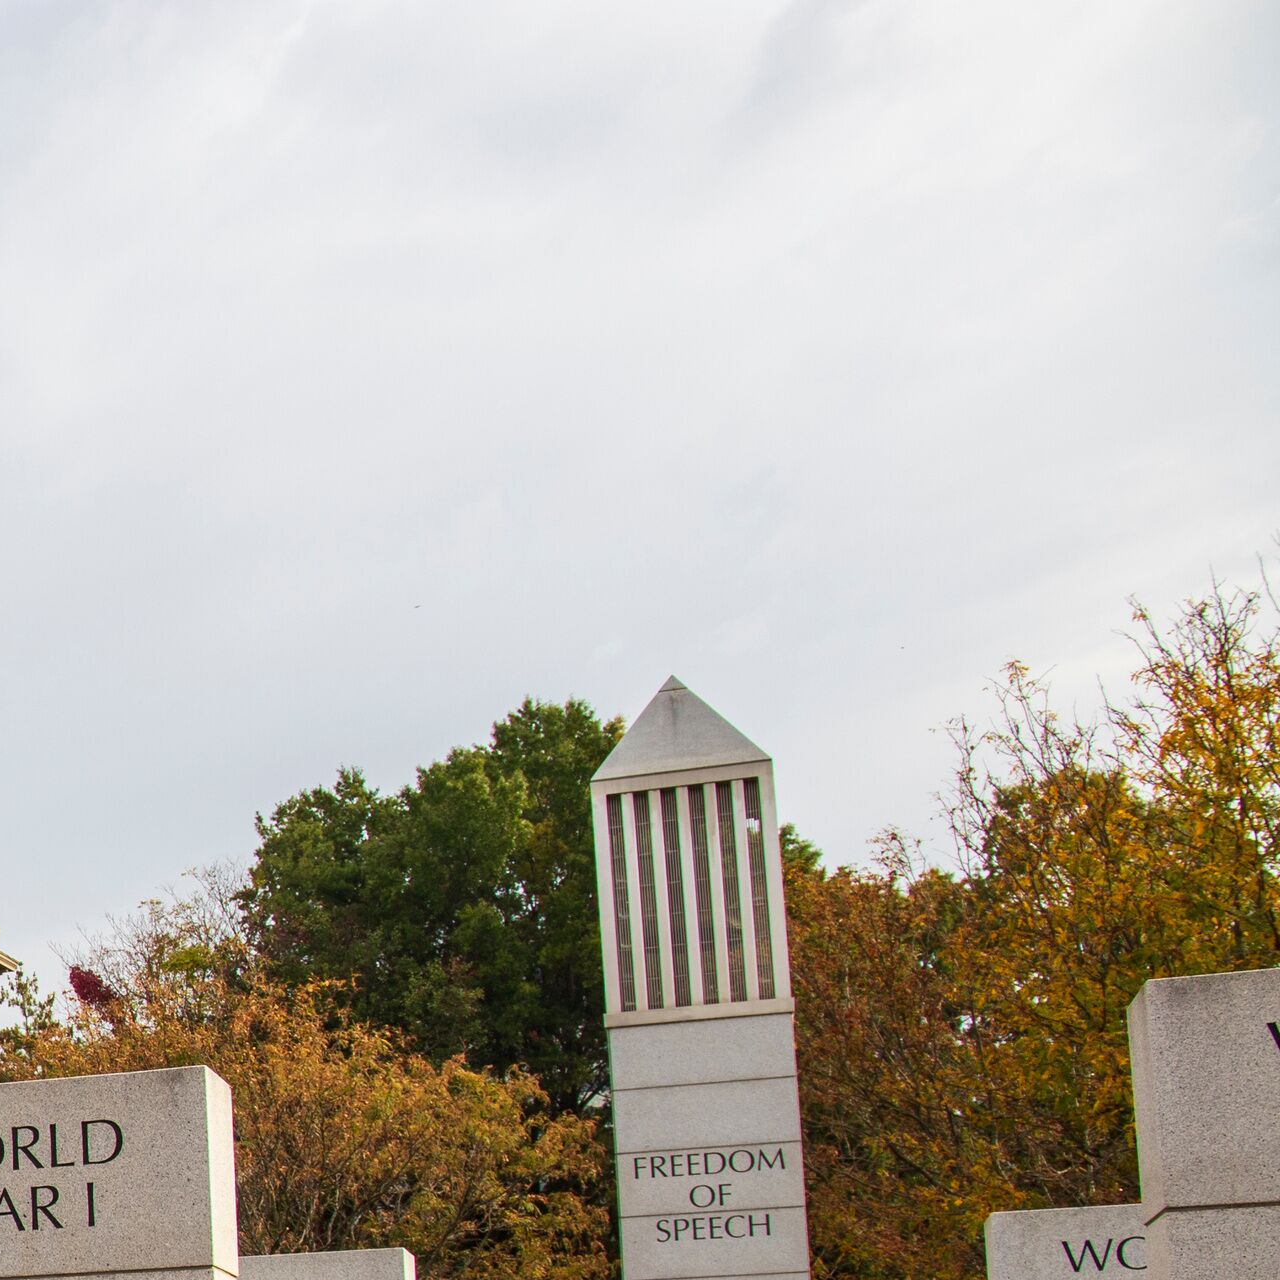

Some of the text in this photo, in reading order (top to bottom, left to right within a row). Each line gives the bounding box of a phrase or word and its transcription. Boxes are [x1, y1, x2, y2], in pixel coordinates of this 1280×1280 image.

[633, 1147, 786, 1179] FREEDOM
[86, 1182, 96, 1227] I
[690, 1183, 732, 1208] OF
[656, 1213, 771, 1243] SPEECH
